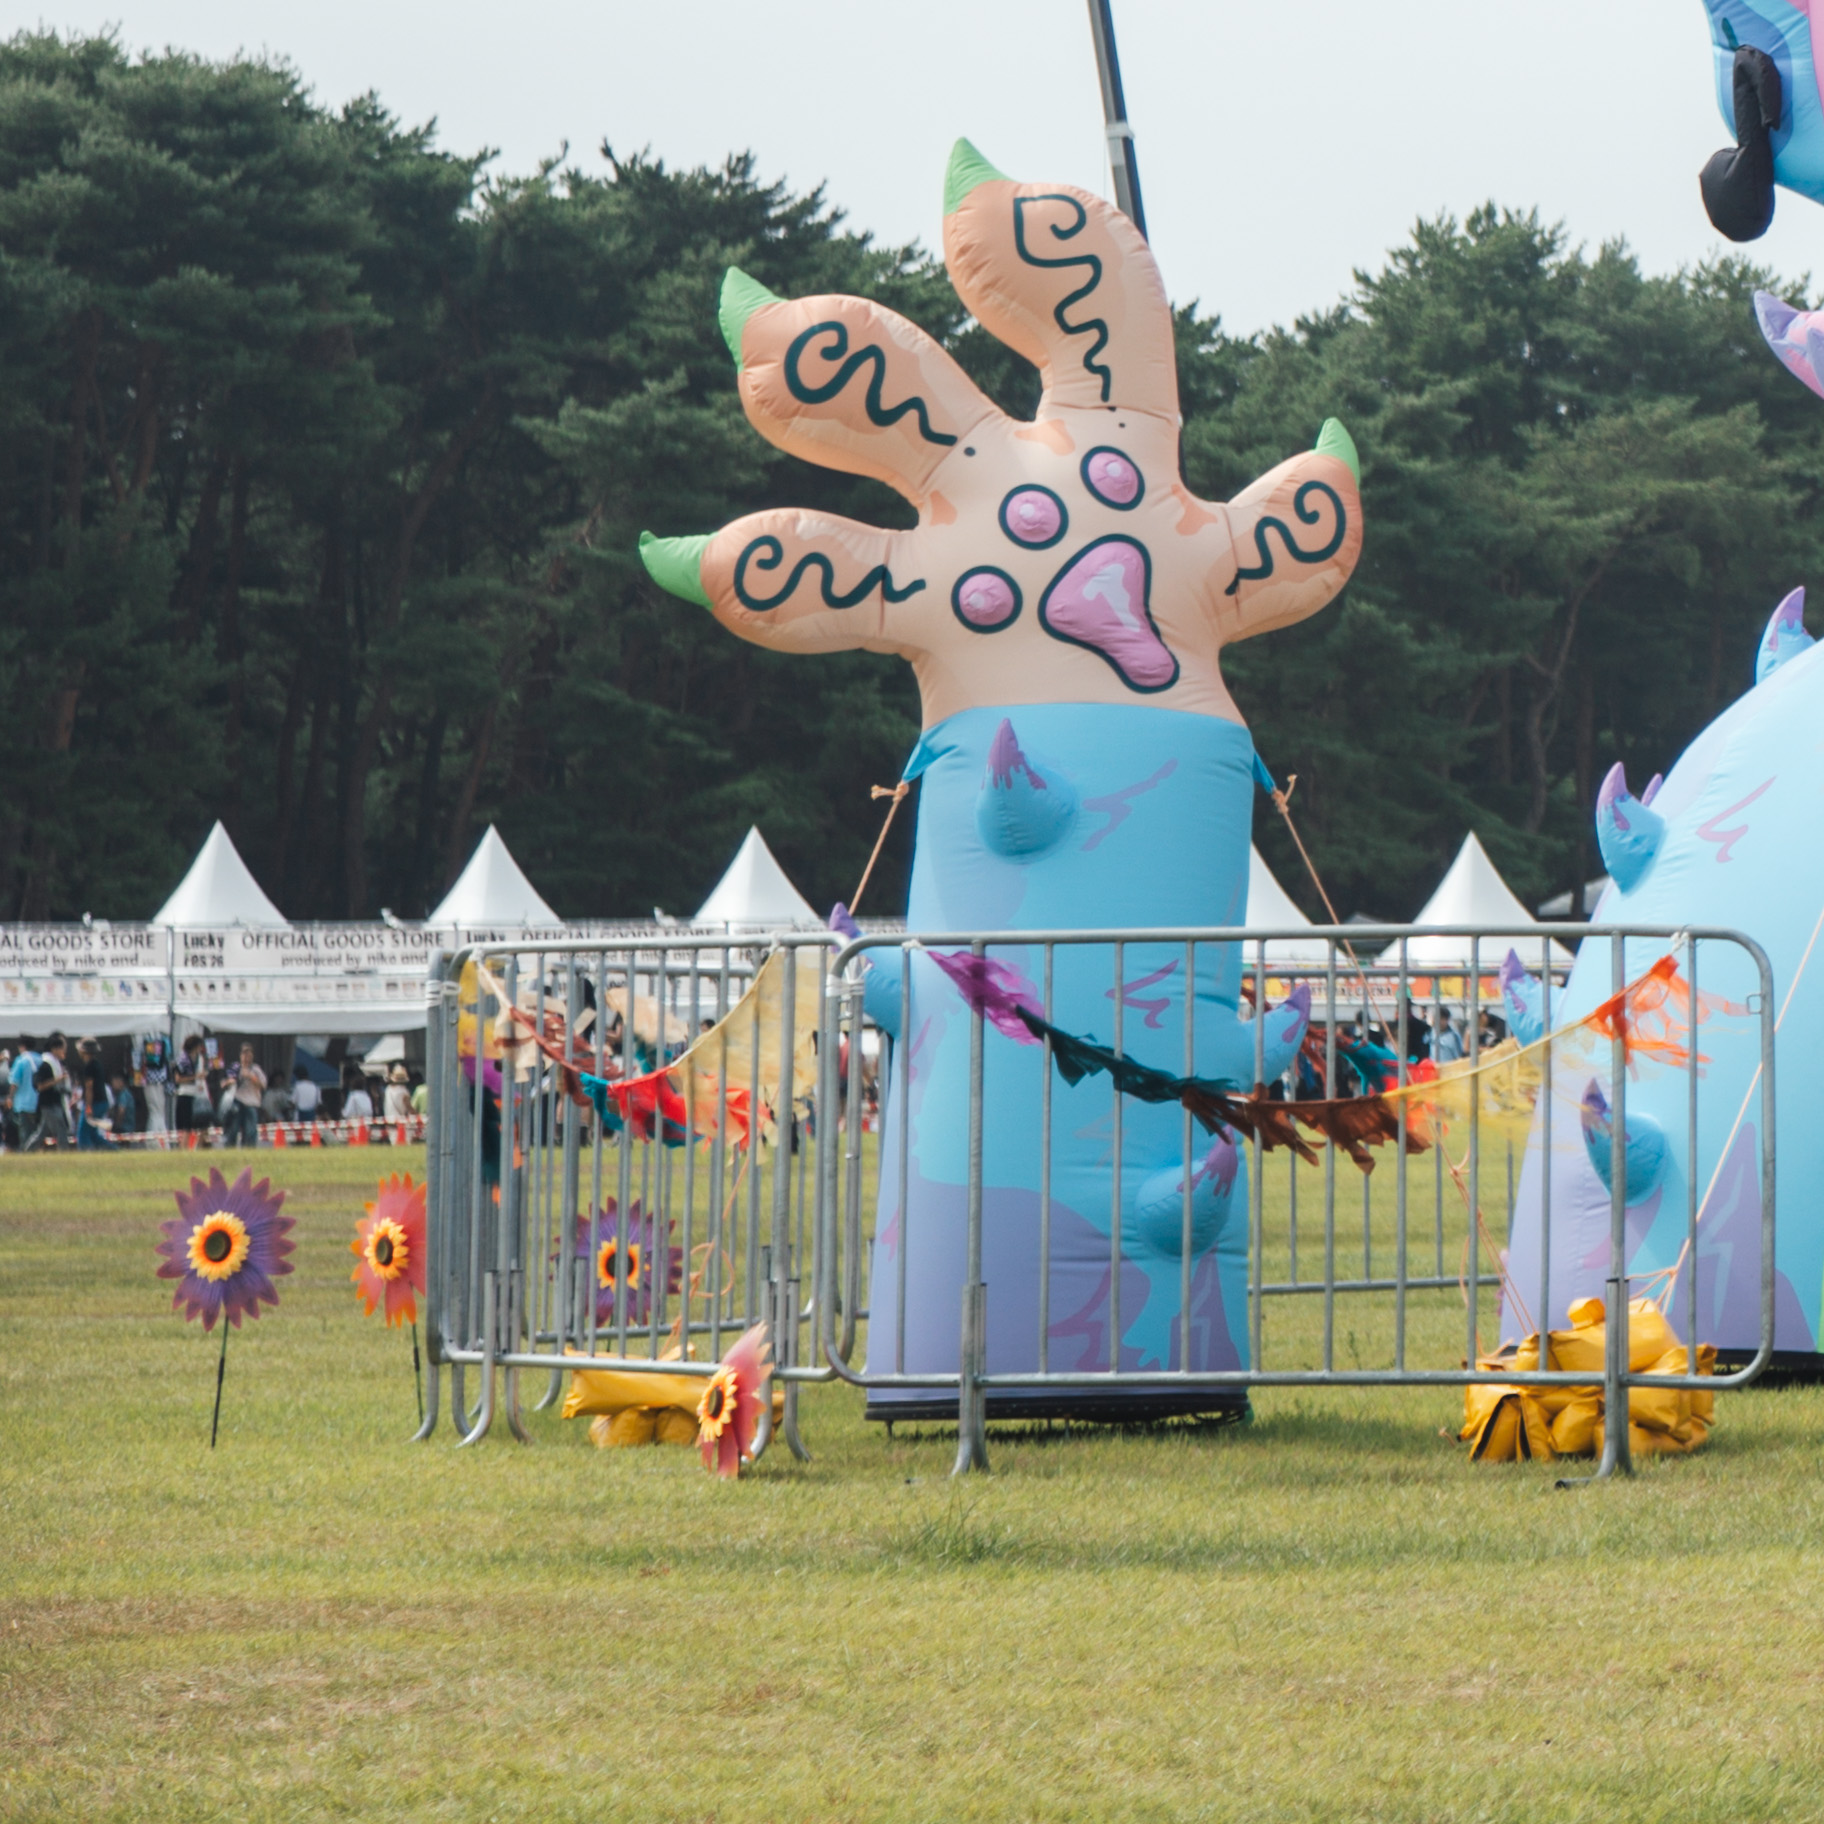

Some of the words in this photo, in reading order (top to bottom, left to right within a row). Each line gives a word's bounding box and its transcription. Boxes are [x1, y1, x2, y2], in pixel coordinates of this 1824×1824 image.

[28, 933, 93, 950] GOODS
[100, 933, 156, 950] STORE
[183, 932, 225, 951] Lucky
[242, 932, 318, 949] OFFICIAL
[323, 932, 384, 949] GOODS
[391, 931, 445, 948] STORE
[281, 953, 342, 969] produced
